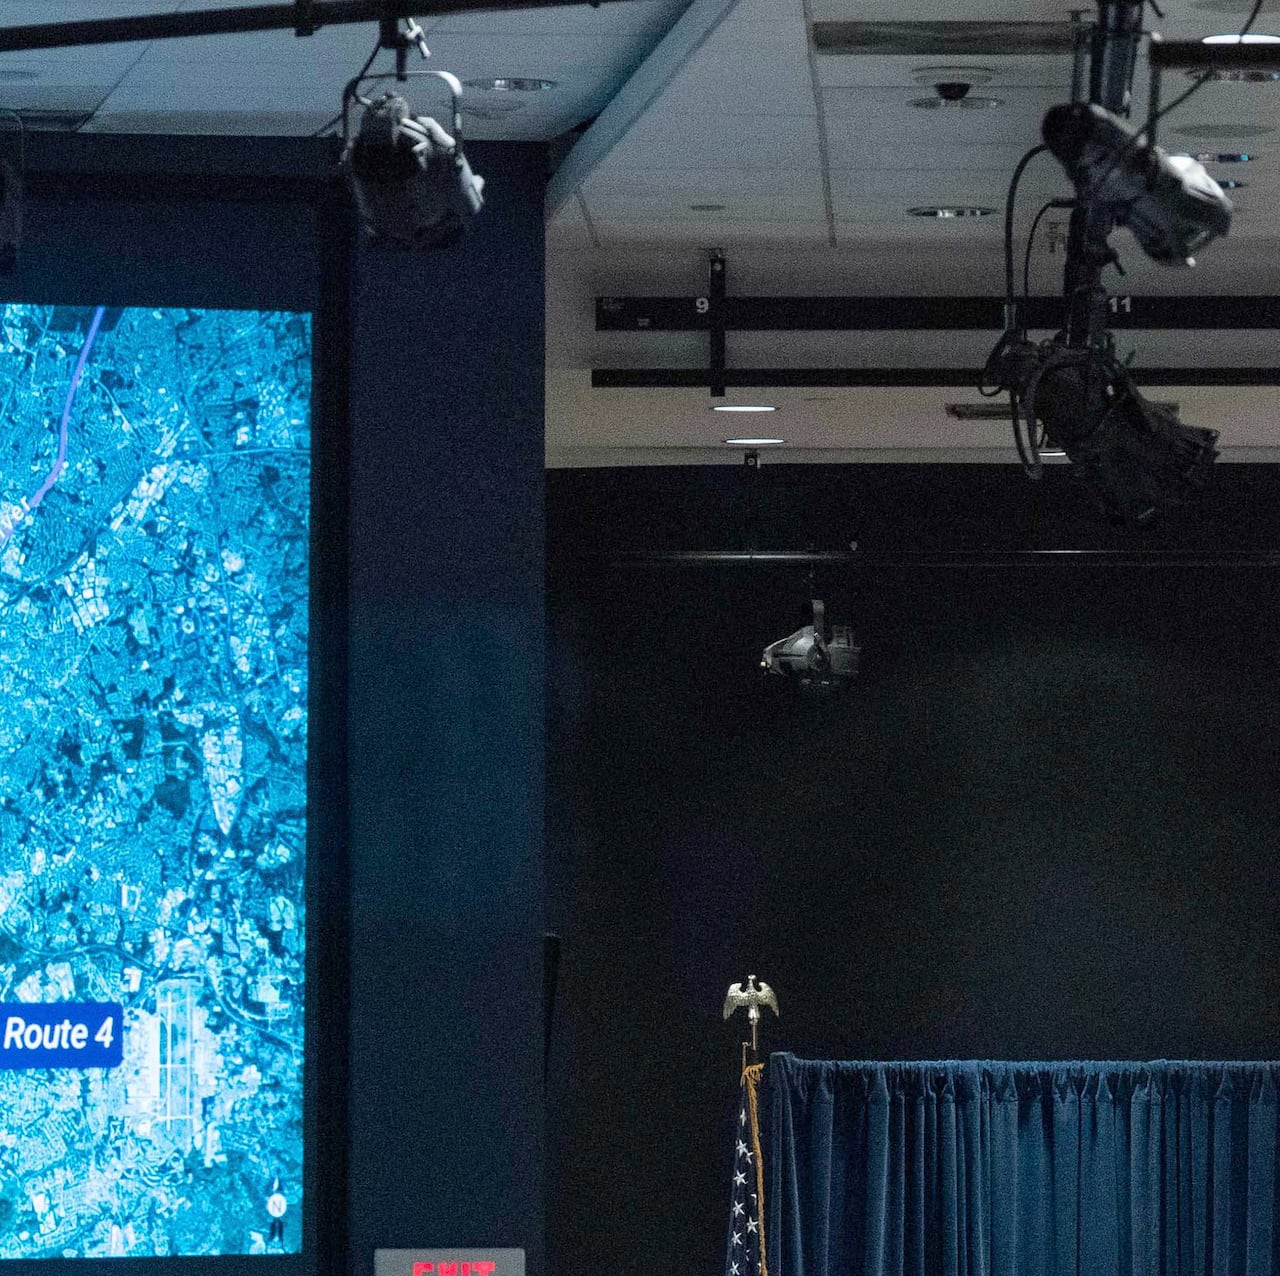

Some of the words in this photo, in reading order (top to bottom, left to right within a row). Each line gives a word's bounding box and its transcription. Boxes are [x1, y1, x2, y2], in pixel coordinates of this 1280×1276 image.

[695, 297, 710, 313] 9
[1109, 297, 1131, 313] 11
[2, 1017, 88, 1050] Route
[94, 1017, 114, 1048] 4
